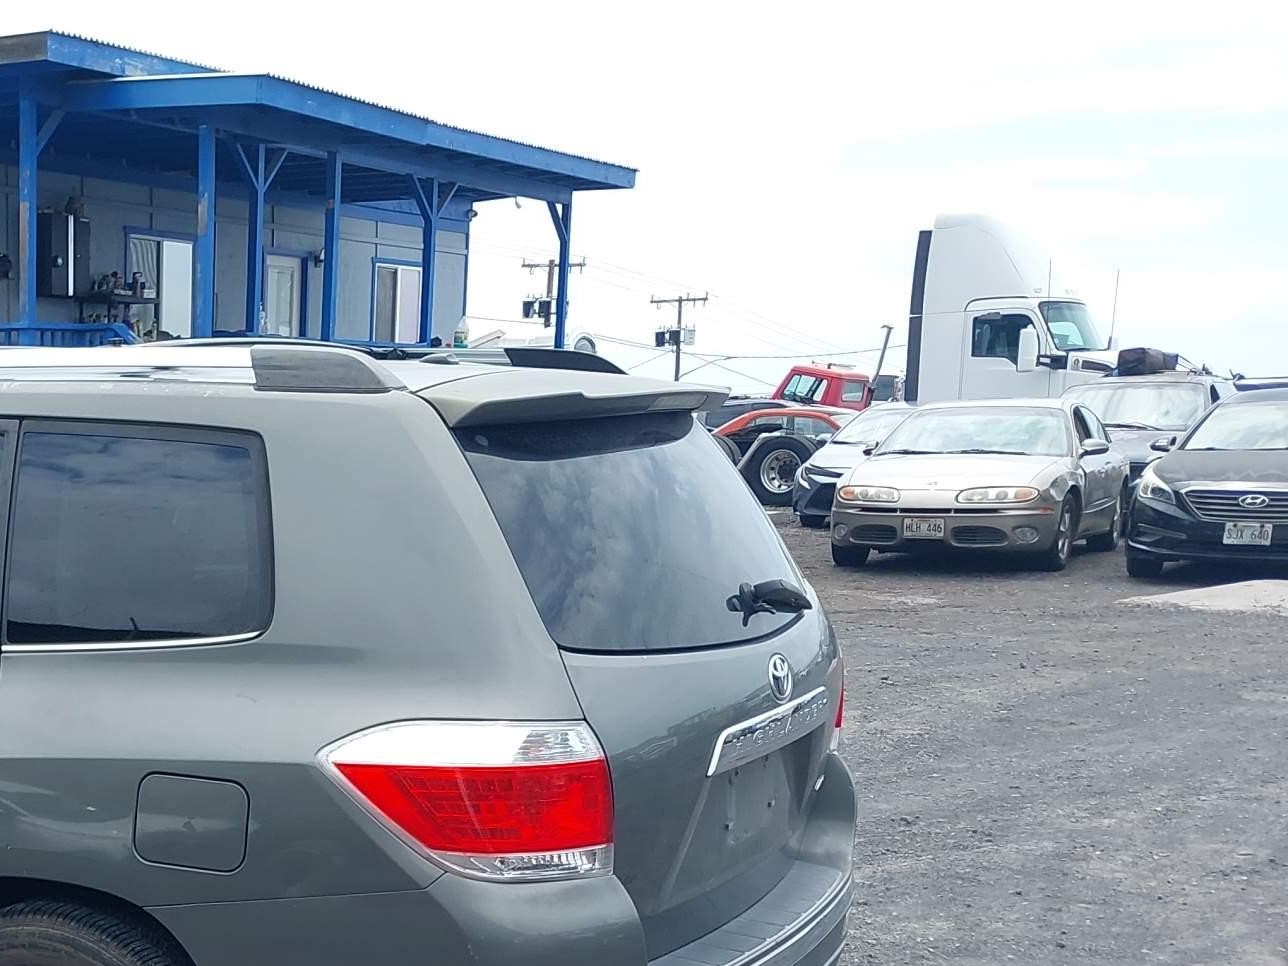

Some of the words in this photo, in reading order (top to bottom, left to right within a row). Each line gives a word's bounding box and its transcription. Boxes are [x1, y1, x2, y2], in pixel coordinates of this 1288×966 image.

[905, 522, 921, 533] HLH
[926, 523, 943, 534] 446
[1226, 528, 1245, 540] SJX
[1250, 529, 1270, 541] 640
